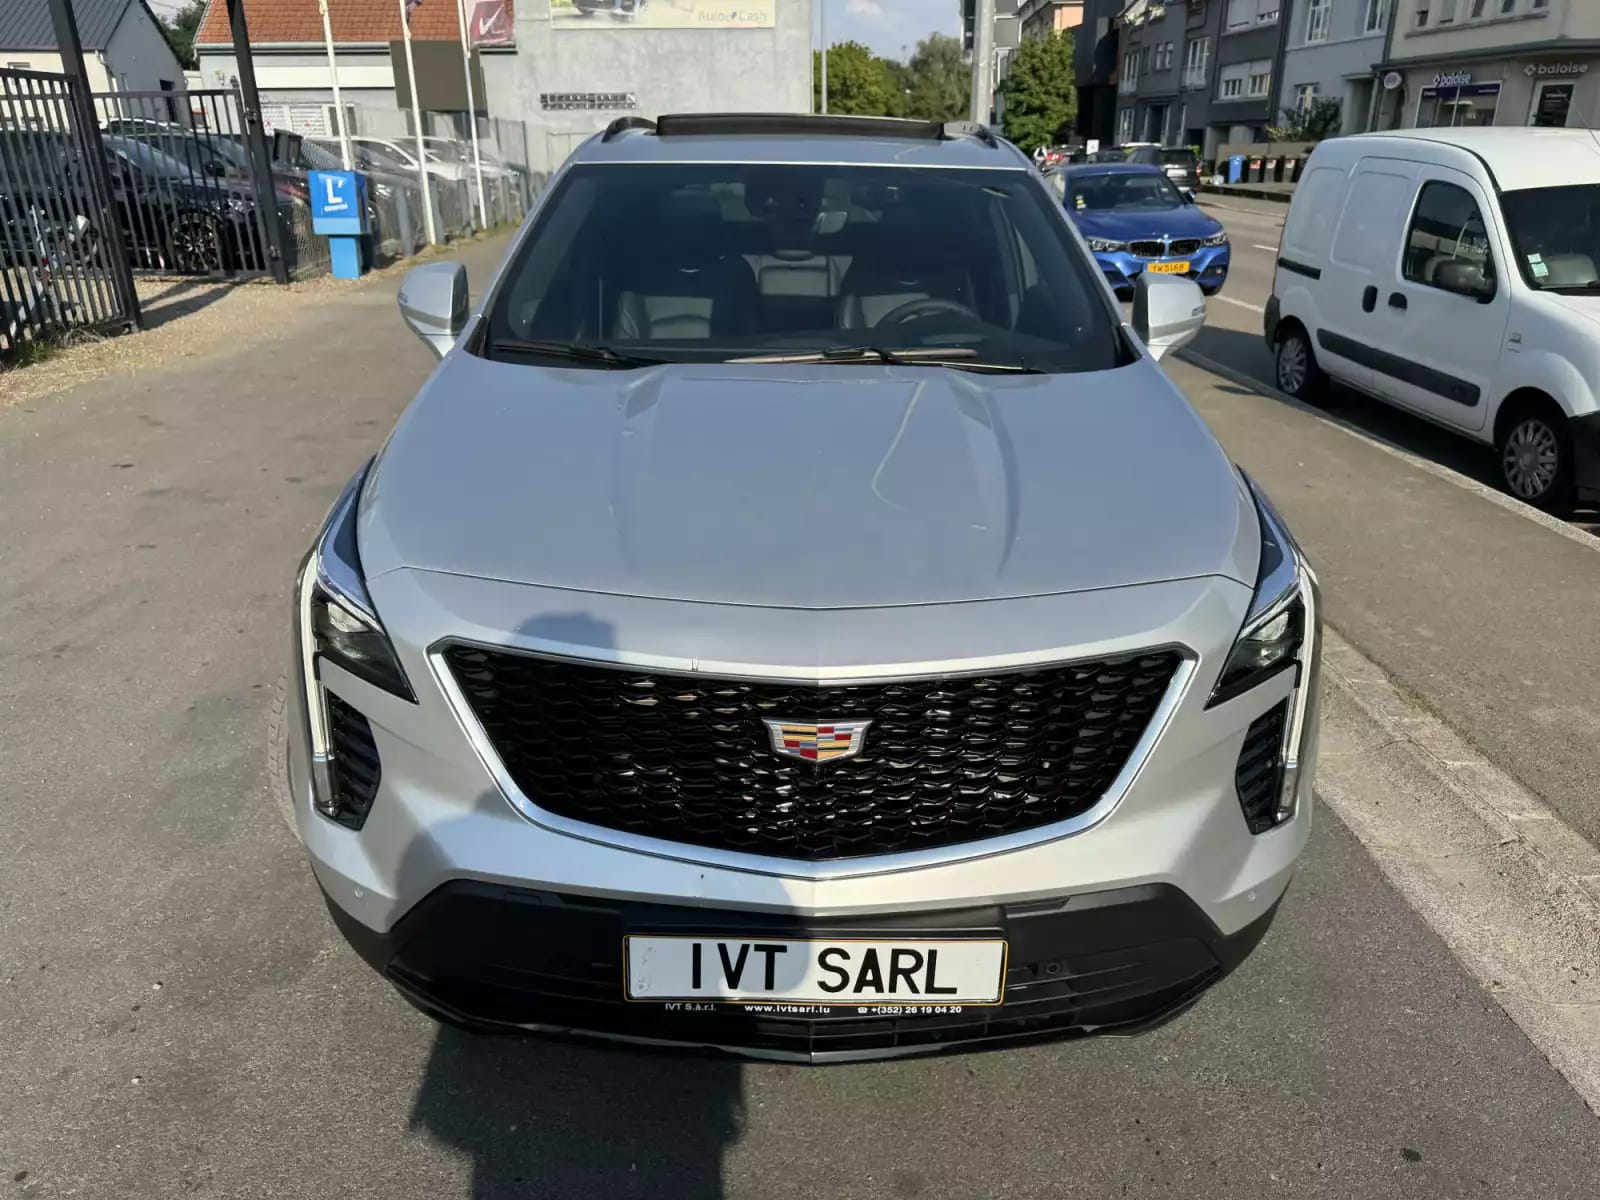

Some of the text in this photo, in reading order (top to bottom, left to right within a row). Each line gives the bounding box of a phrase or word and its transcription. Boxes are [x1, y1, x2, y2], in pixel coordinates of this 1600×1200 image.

[1537, 62, 1589, 75] baloise
[1439, 71, 1471, 87] baloise
[692, 942, 957, 994] IVT SARL
[665, 1003, 683, 1011] IVT
[744, 1004, 830, 1014] www.ivtsarl.lu
[871, 1006, 903, 1015] +(352)
[921, 1006, 932, 1014] 19
[935, 1006, 947, 1014] 04
[949, 1005, 962, 1014] 20
